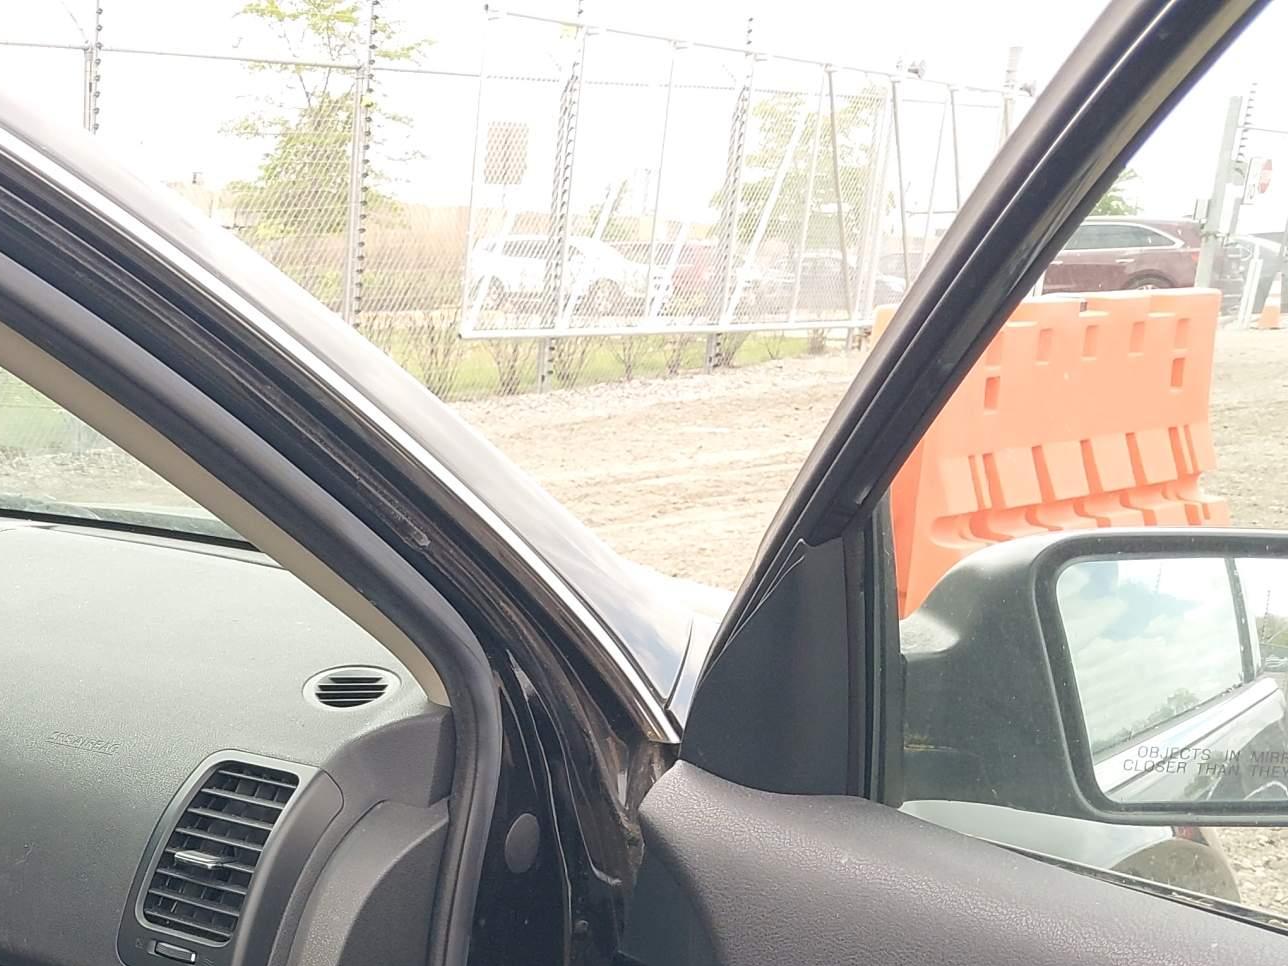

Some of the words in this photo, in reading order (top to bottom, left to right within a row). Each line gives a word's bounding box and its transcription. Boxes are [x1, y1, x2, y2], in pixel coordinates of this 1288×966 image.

[1137, 745, 1212, 761] OBJECTS
[1224, 749, 1241, 762] IN
[1123, 758, 1187, 774] CLOSER
[1196, 762, 1240, 776] THAN
